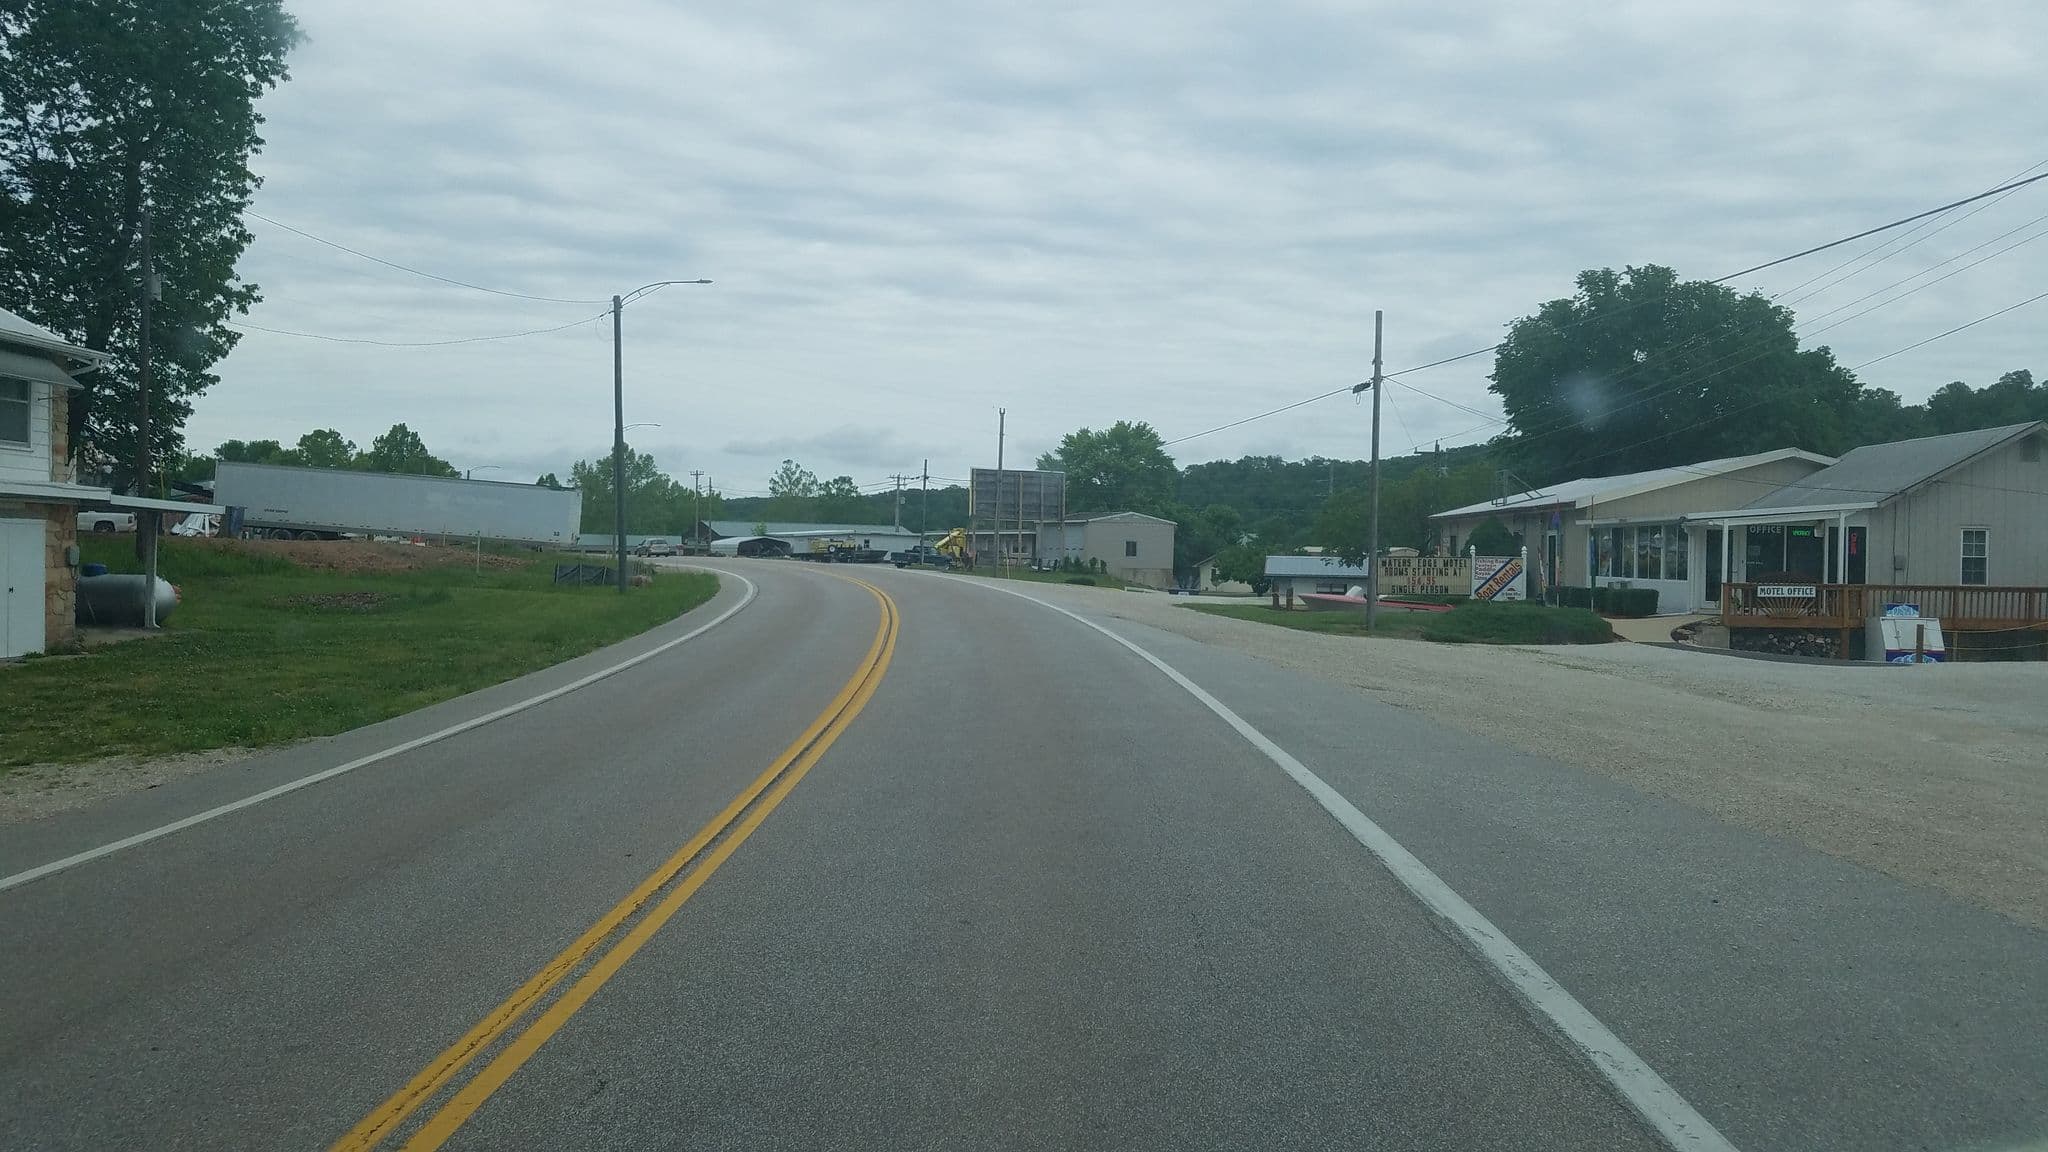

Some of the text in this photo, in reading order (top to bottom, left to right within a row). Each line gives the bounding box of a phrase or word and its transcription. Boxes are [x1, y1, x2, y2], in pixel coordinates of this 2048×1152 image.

[1749, 525, 1782, 534] OFFICE
[1381, 559, 1467, 567] WATERS EDGE MOTEL
[1385, 567, 1462, 576] ROOMS STARTING AT
[1476, 562, 1521, 600] Boat Rentals
[1391, 585, 1449, 594] SINGLE PERSON
[1759, 587, 1814, 596] MOTEL OFFICE
